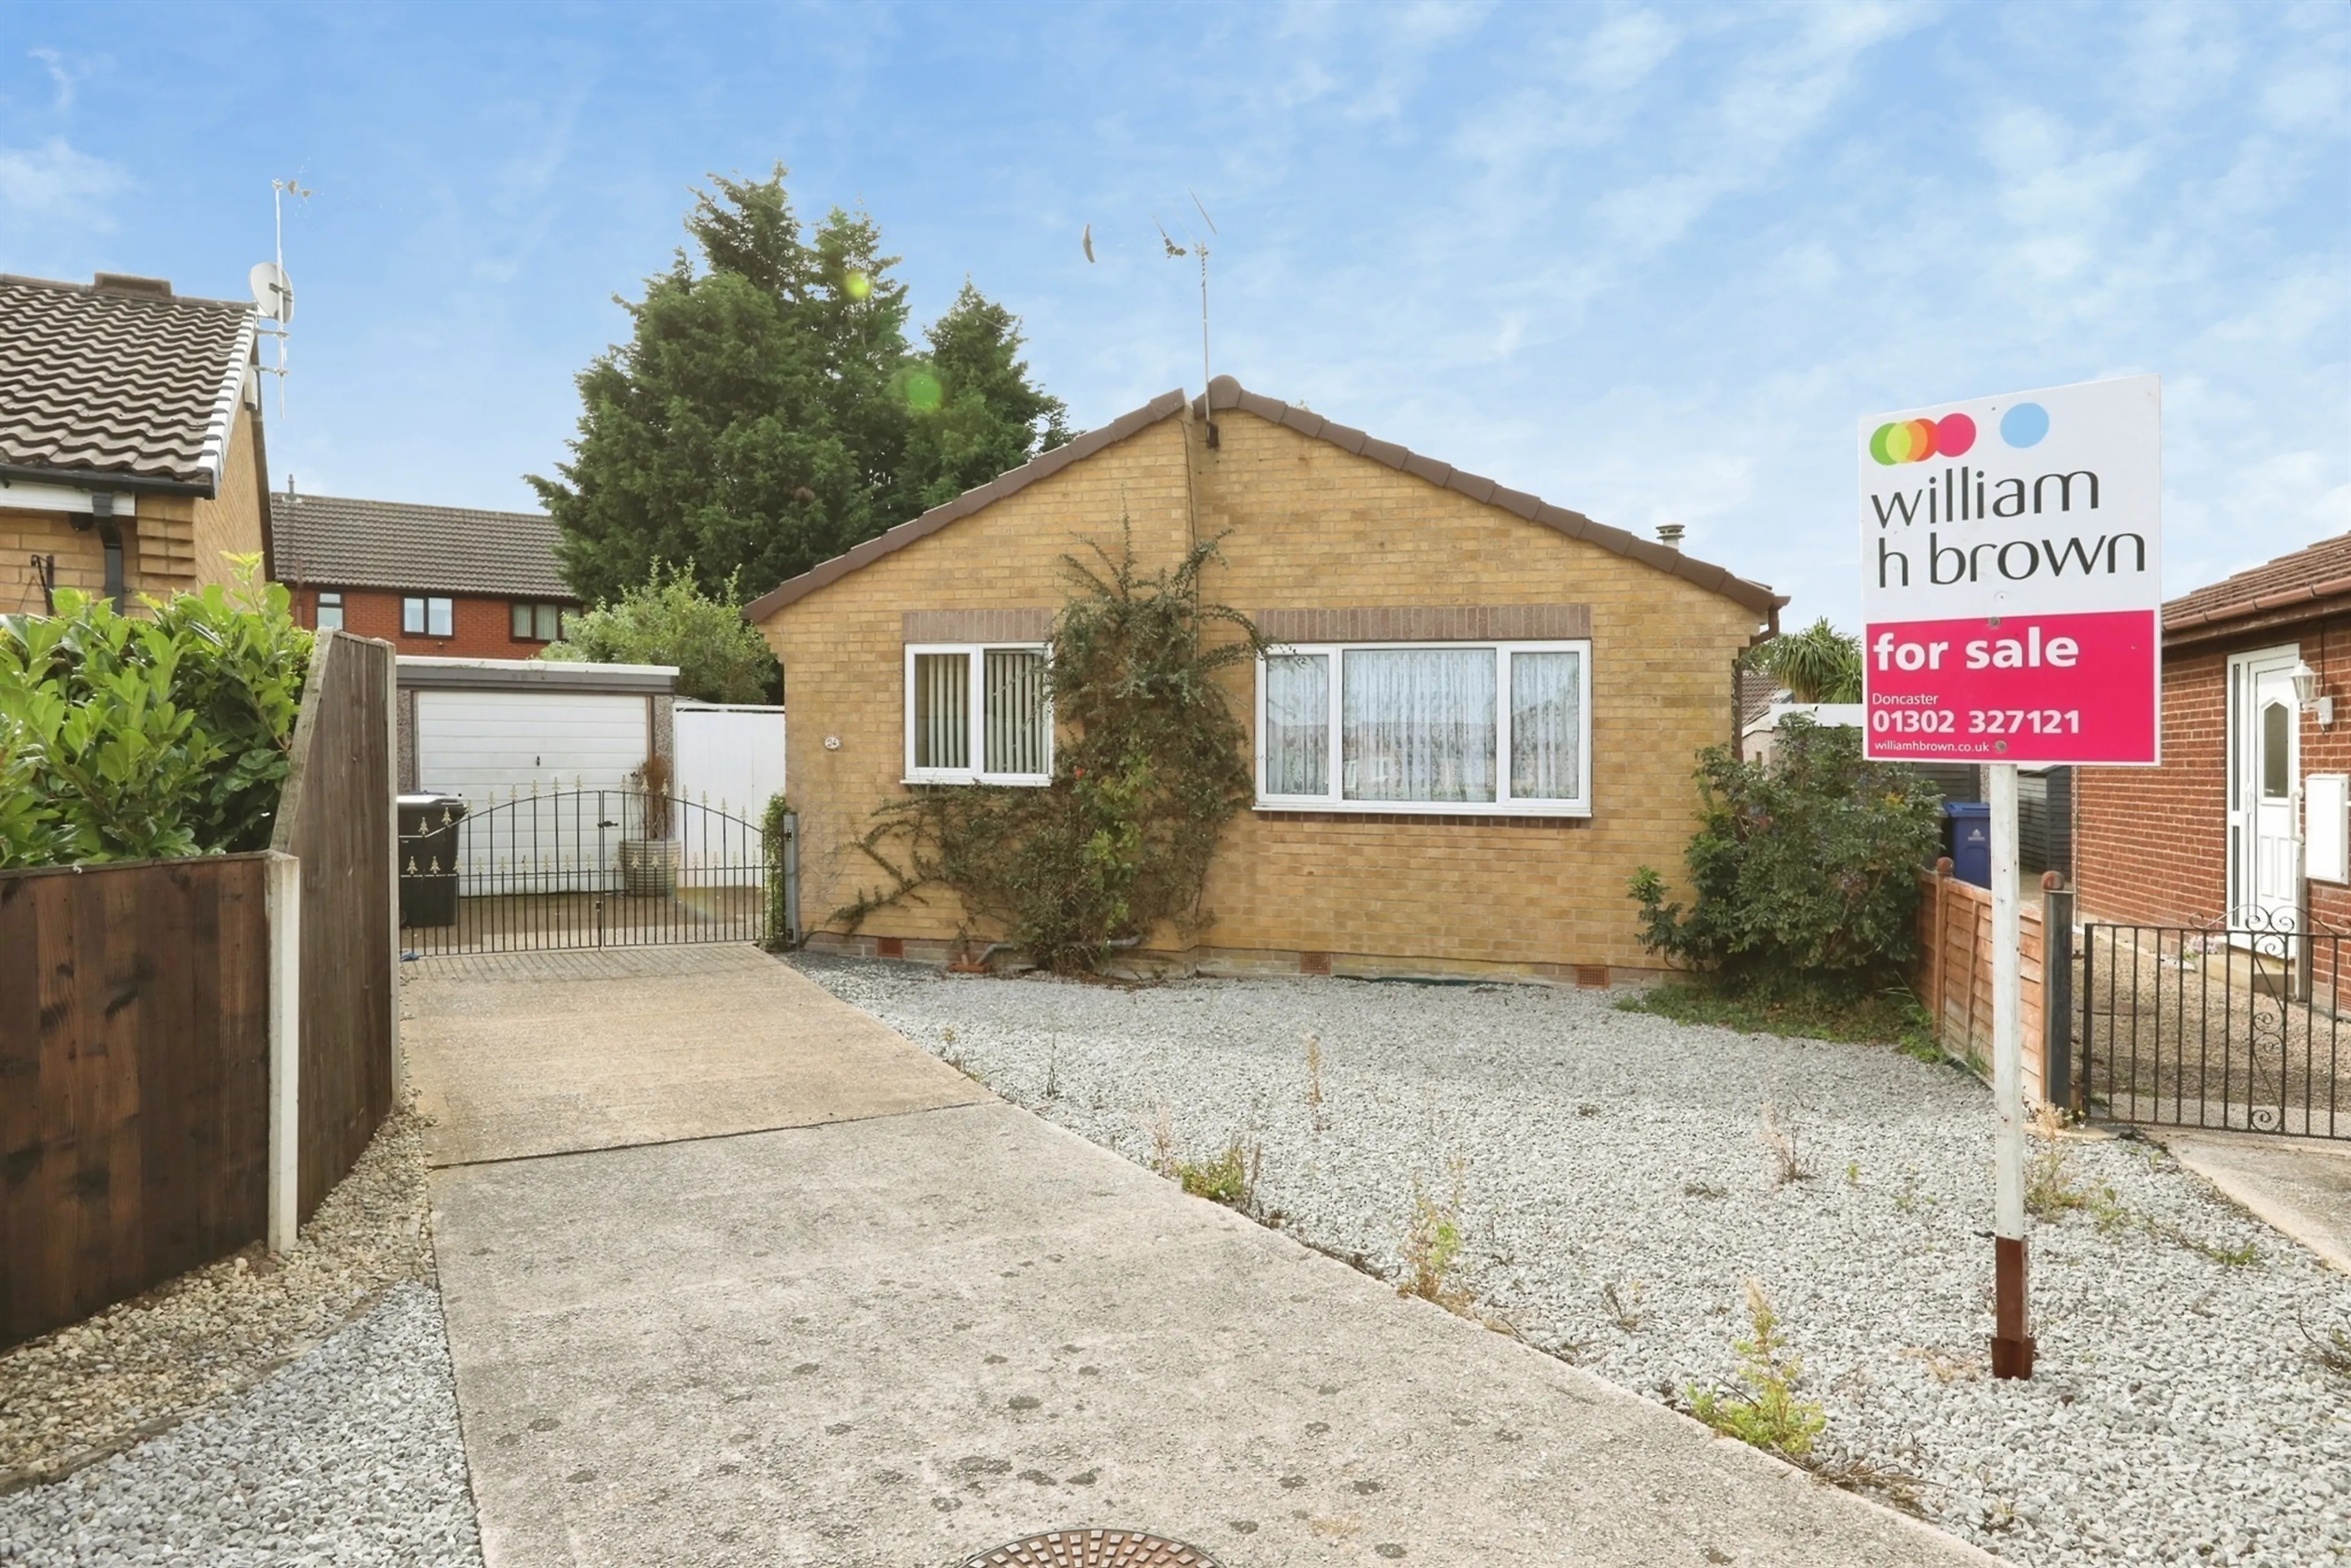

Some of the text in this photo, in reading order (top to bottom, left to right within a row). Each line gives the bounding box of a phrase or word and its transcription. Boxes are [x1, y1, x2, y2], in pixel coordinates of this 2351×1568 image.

[1872, 467, 2099, 528] william
[1879, 532, 2145, 588] h brown
[1873, 627, 2079, 670] for sale
[1872, 693, 1938, 705] Doncaster
[1872, 710, 2079, 733] 01302 327121
[1875, 740, 1989, 752] williamhbrown.co.uk
